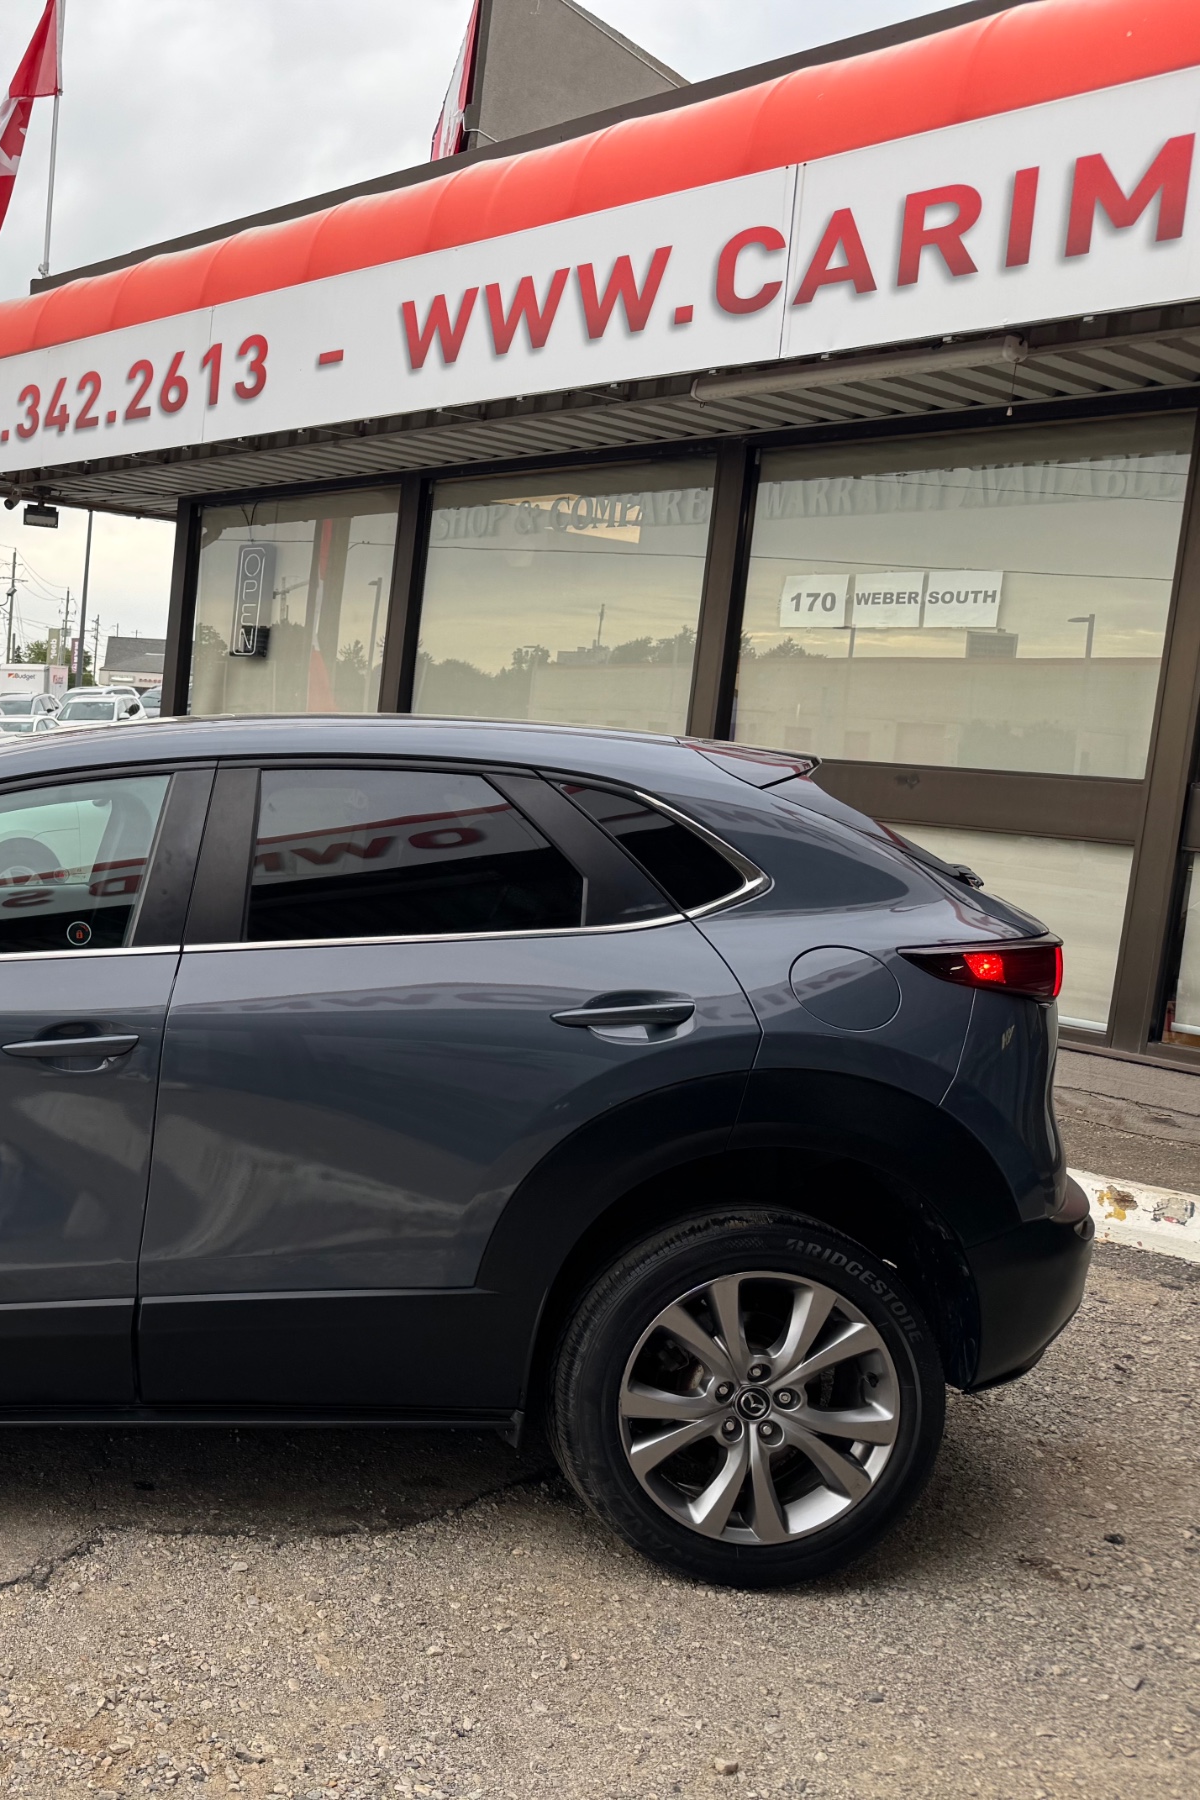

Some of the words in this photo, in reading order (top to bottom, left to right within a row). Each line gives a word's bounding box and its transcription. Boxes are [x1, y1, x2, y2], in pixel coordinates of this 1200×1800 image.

[400, 132, 1196, 369] WWW.CARIM
[434, 505, 504, 540] SHOP
[515, 500, 541, 535] &
[551, 489, 709, 532] COMPARE
[238, 553, 261, 652] OPEN
[789, 591, 837, 613] 170
[855, 591, 919, 606] WEBER
[927, 590, 997, 605] SOUTH
[14, 673, 36, 681] Budget
[786, 1238, 925, 1344] BRIDGESTONE
